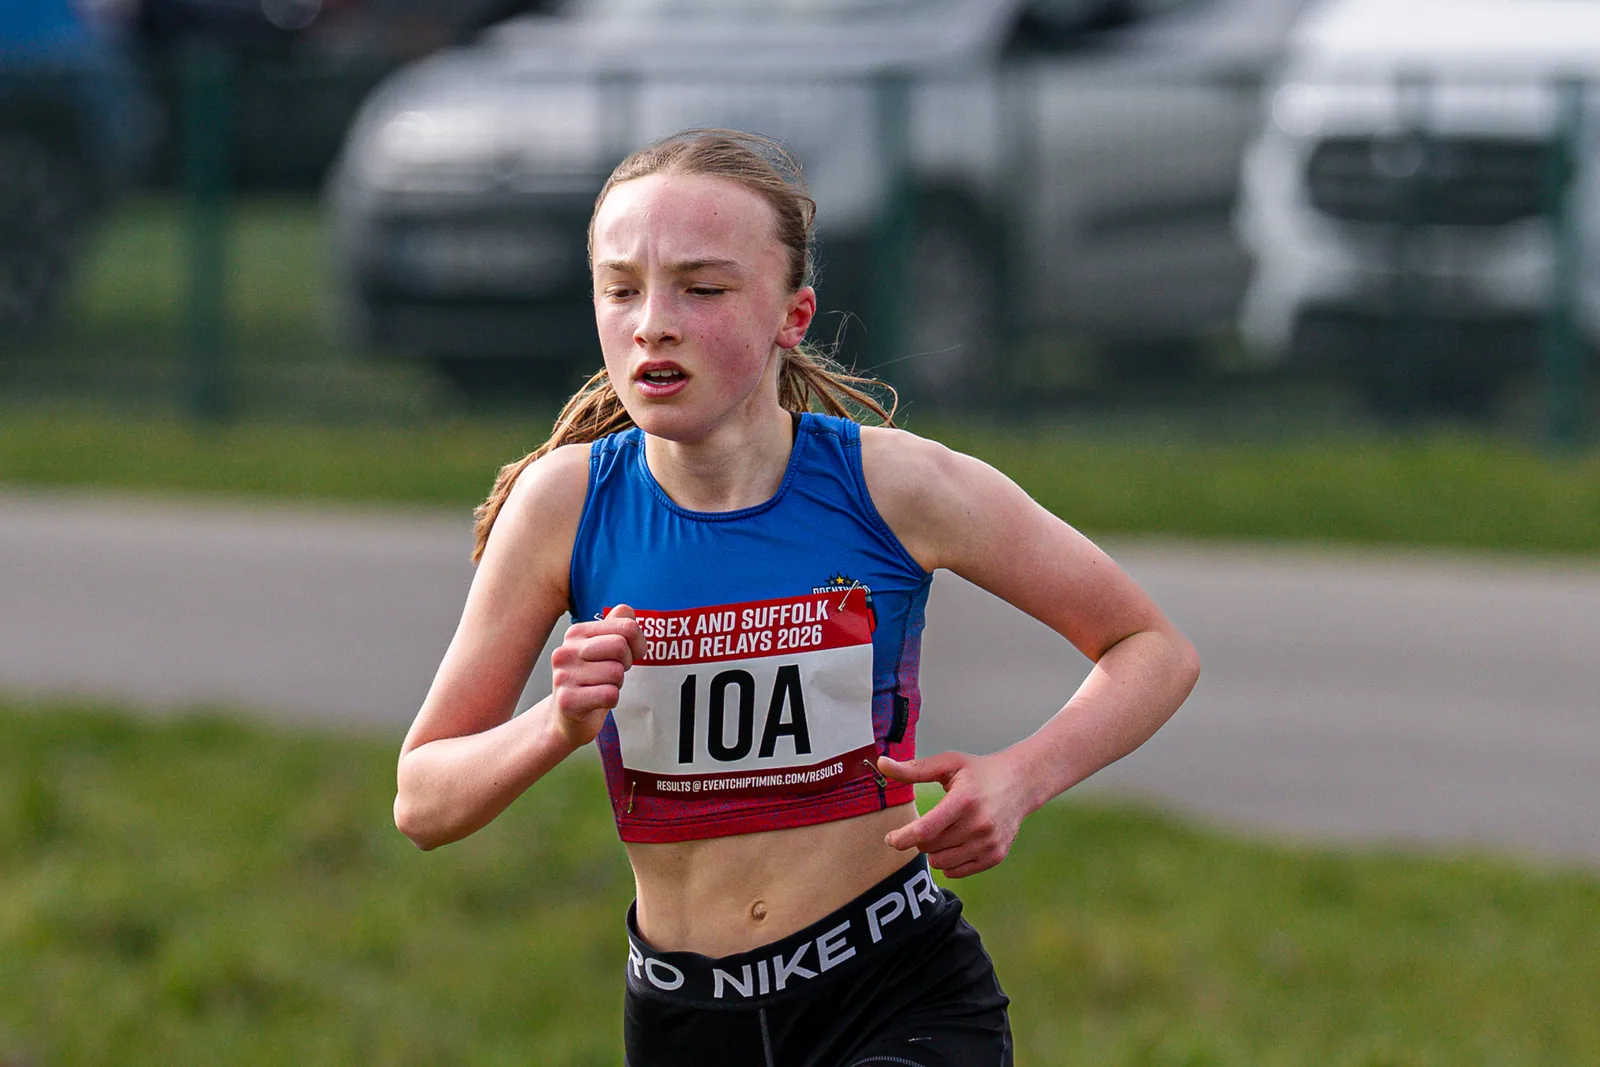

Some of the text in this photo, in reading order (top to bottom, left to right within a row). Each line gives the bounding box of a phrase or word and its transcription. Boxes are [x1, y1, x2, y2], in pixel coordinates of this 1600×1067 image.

[694, 611, 736, 635] AND
[741, 600, 829, 630] SUFFOLK
[643, 624, 822, 660] ROAD RELAYS 2026
[678, 664, 812, 764] 10A
[656, 762, 843, 792] RESULTS @ EVENTCHIPTIMING.COM/RESULTS
[628, 868, 939, 999] RO NIKE PR
